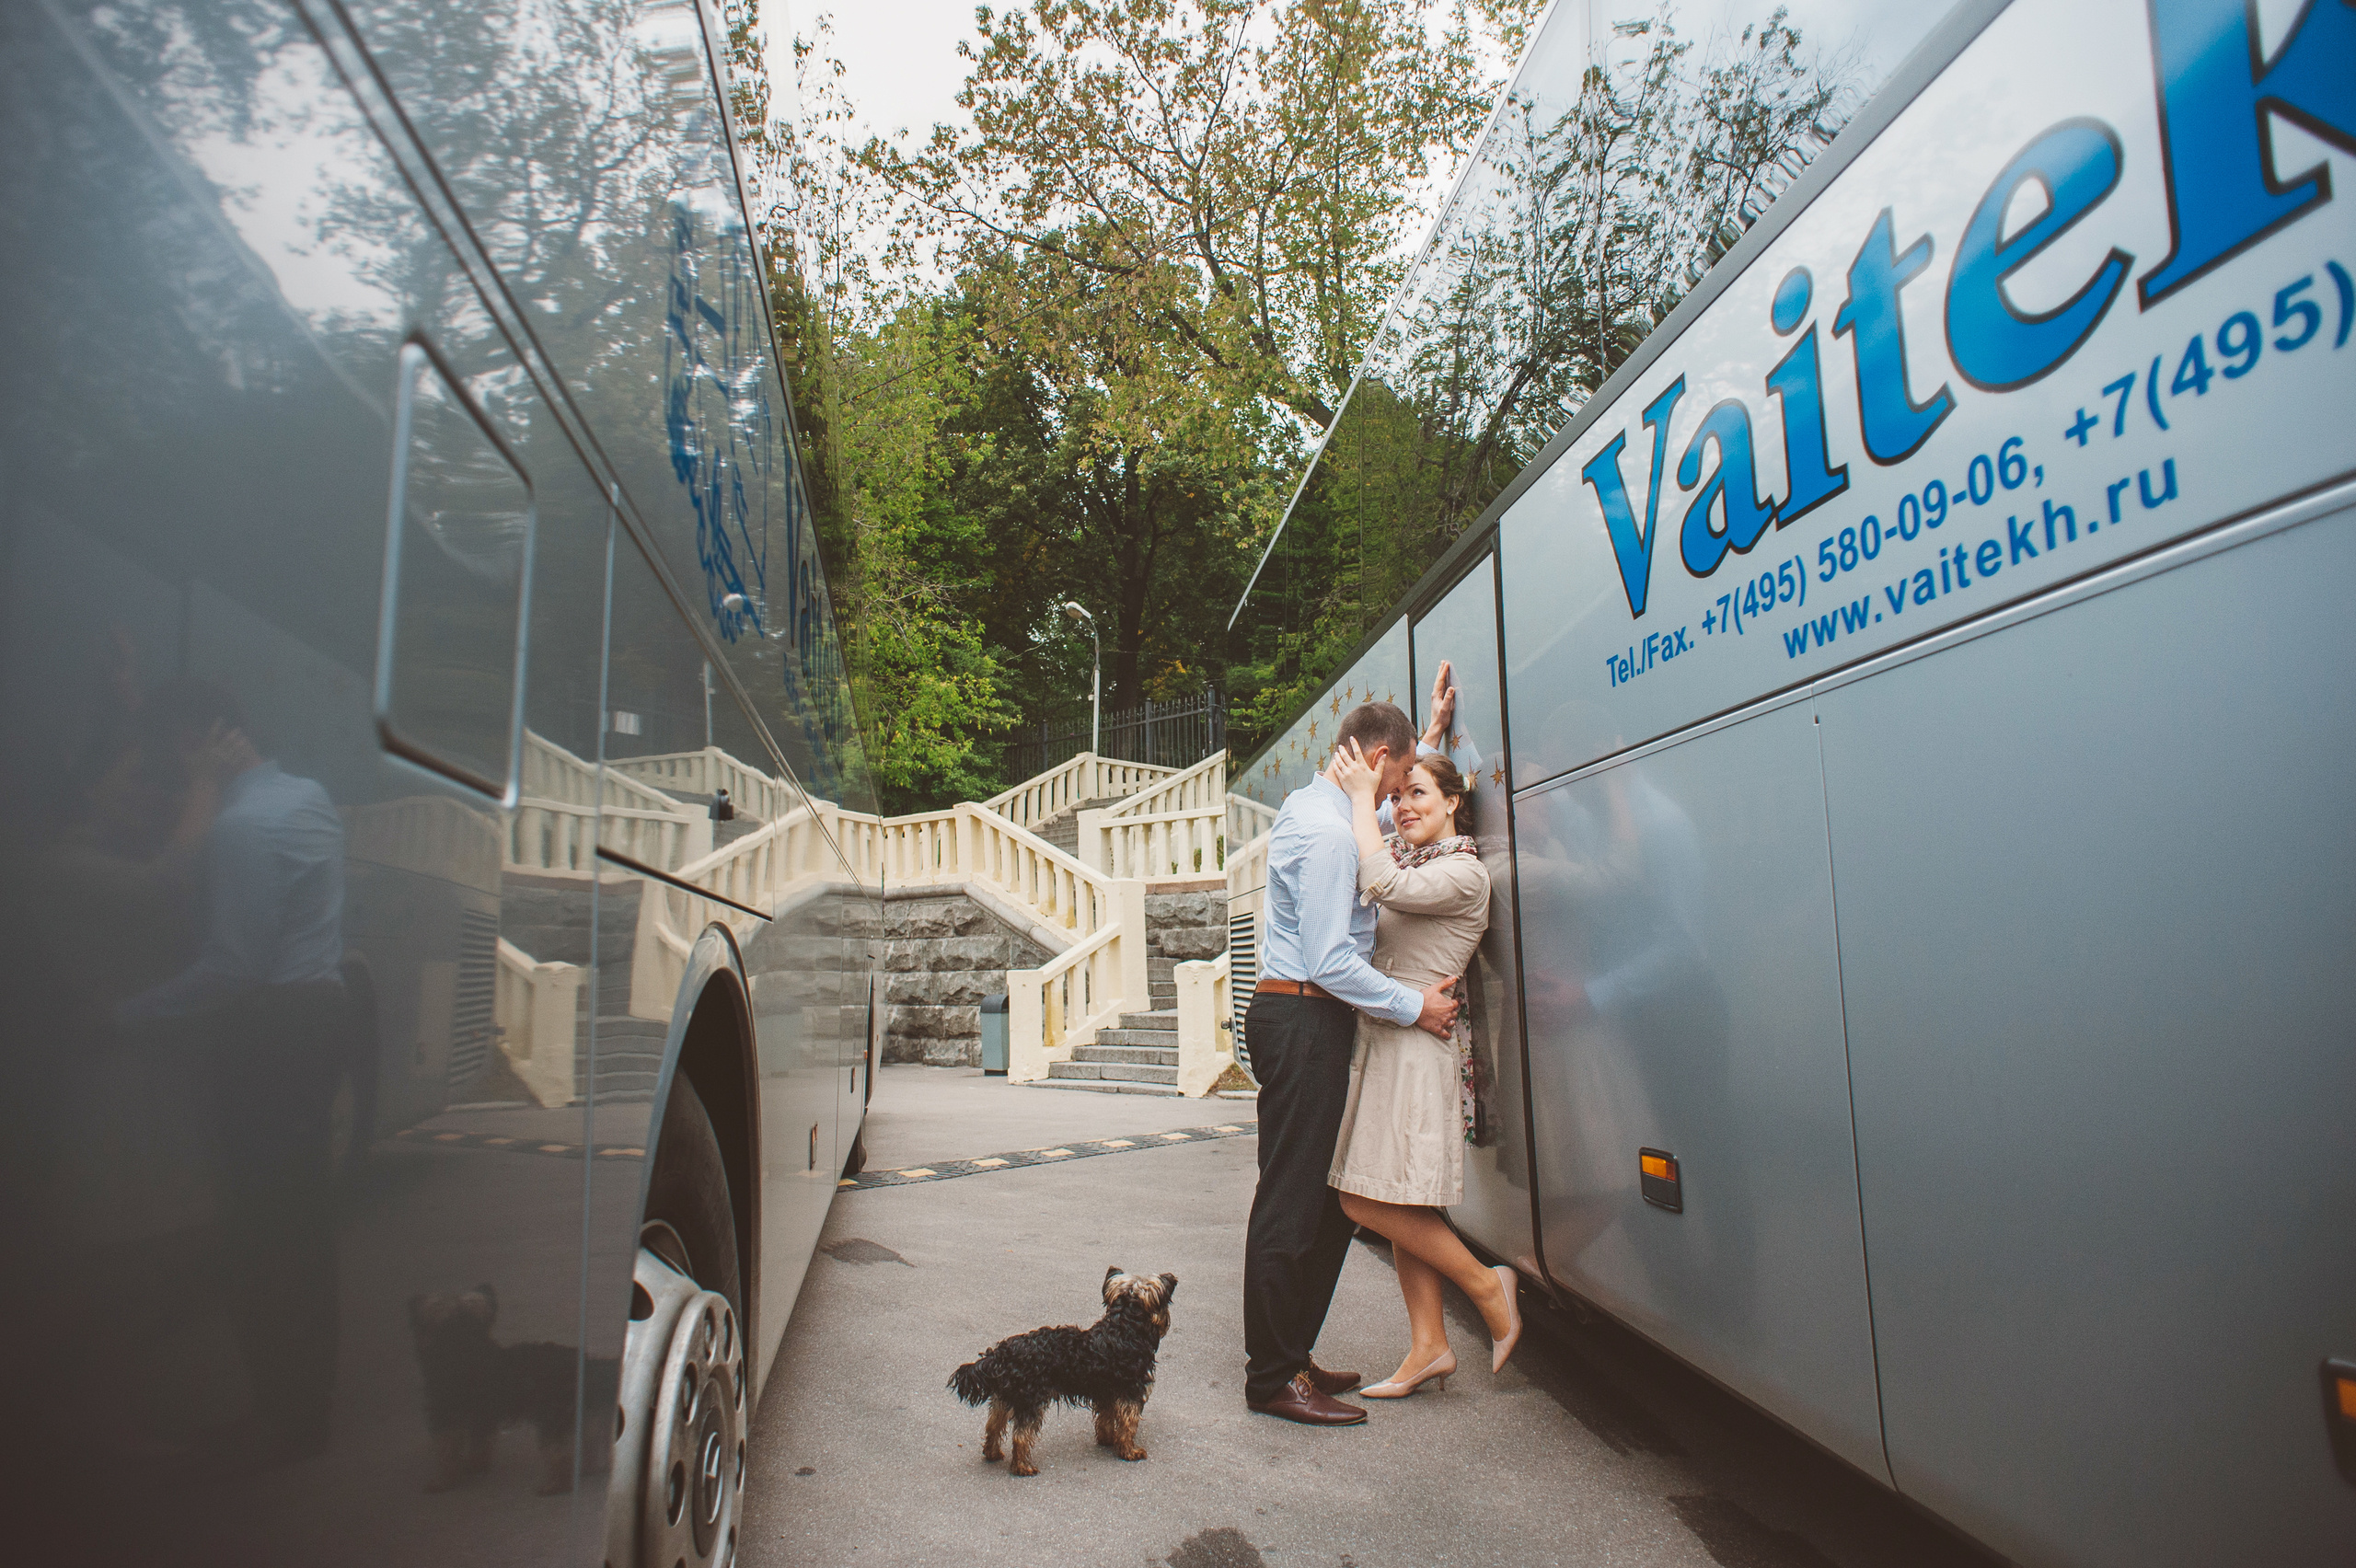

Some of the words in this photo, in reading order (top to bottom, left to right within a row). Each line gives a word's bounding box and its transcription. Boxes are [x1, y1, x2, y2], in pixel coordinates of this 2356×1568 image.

[1606, 632, 1694, 687] Tel./Fax.
[1702, 555, 1806, 635] +7(495)
[1818, 436, 2044, 582] 580-09-06,
[2064, 259, 2356, 447] +7(495)
[1783, 457, 2178, 659] www.vaitekh.ru
